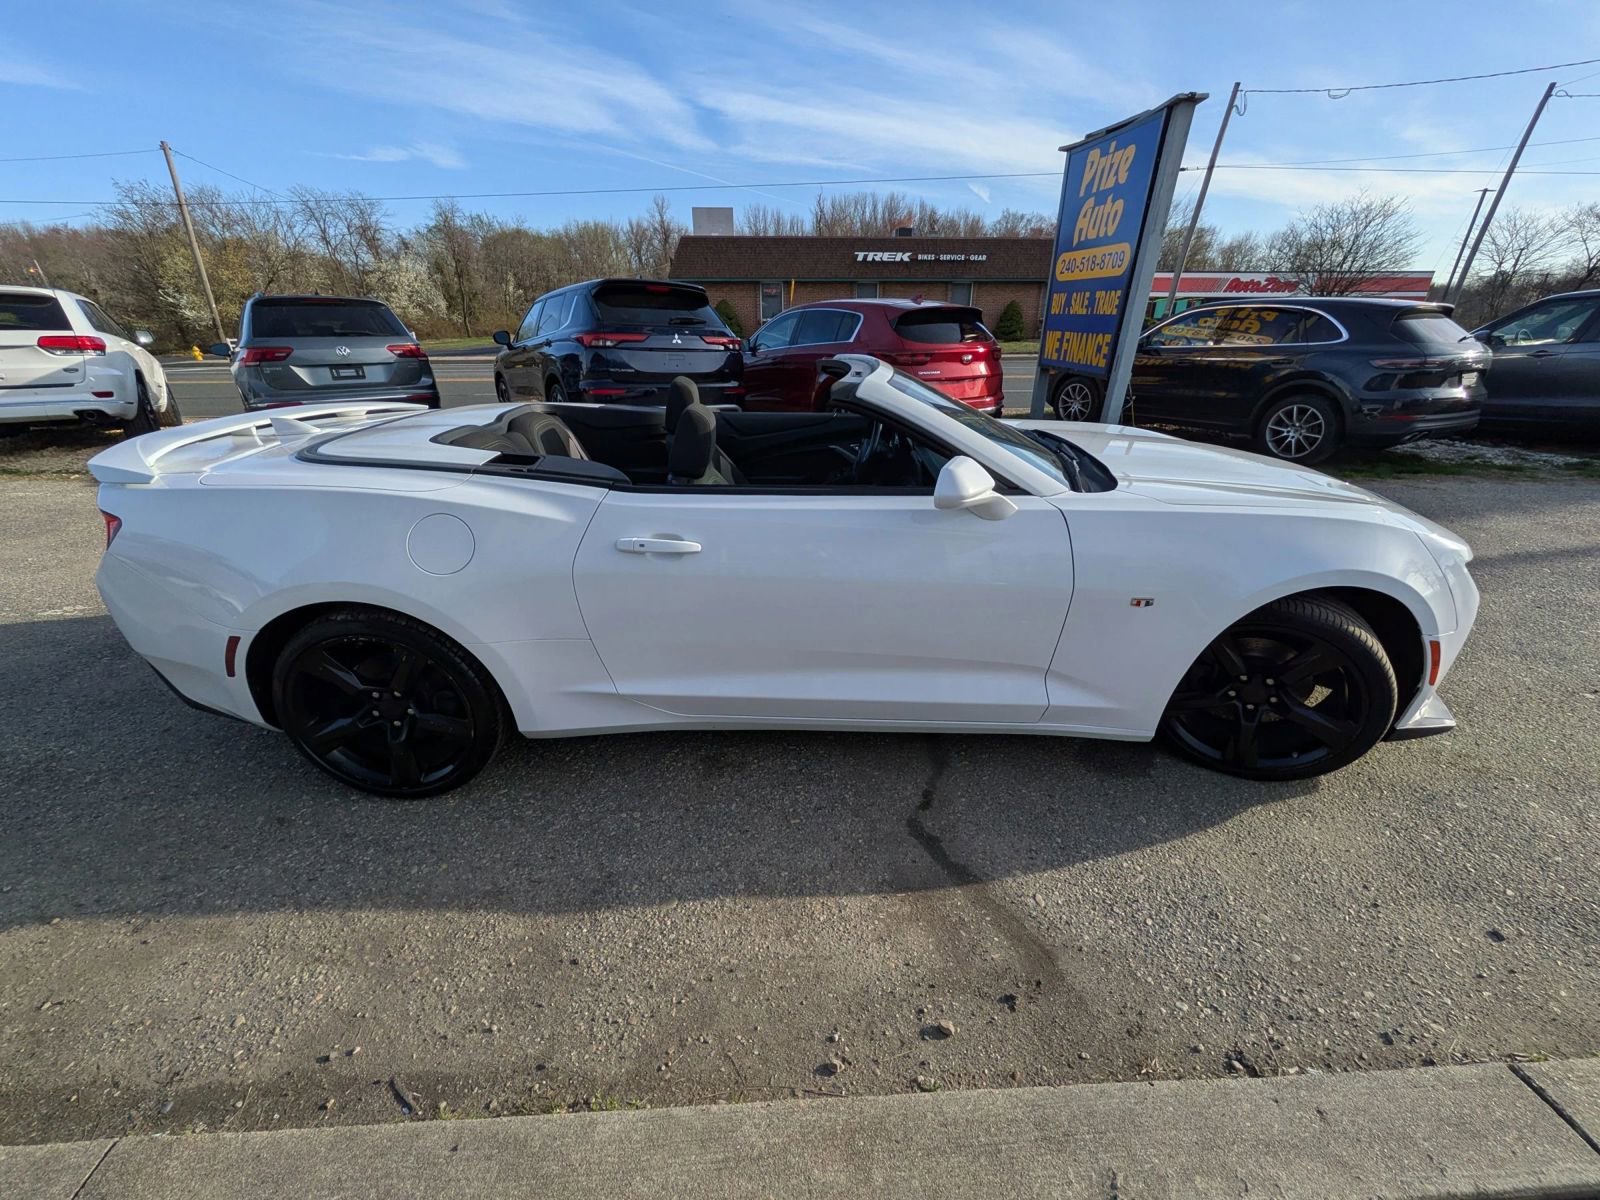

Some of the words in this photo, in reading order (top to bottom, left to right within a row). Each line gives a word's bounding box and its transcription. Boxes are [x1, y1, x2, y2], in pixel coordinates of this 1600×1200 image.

[1080, 140, 1136, 197] Prize
[1073, 194, 1124, 247] Auto
[854, 252, 912, 262] TREK
[1060, 250, 1125, 275] 240-518-8709
[1051, 293, 1067, 315] BUY
[1070, 291, 1090, 315] SALE
[1094, 290, 1121, 315] TRADE
[1044, 331, 1062, 360] WE
[1061, 332, 1112, 368] FINANCE
